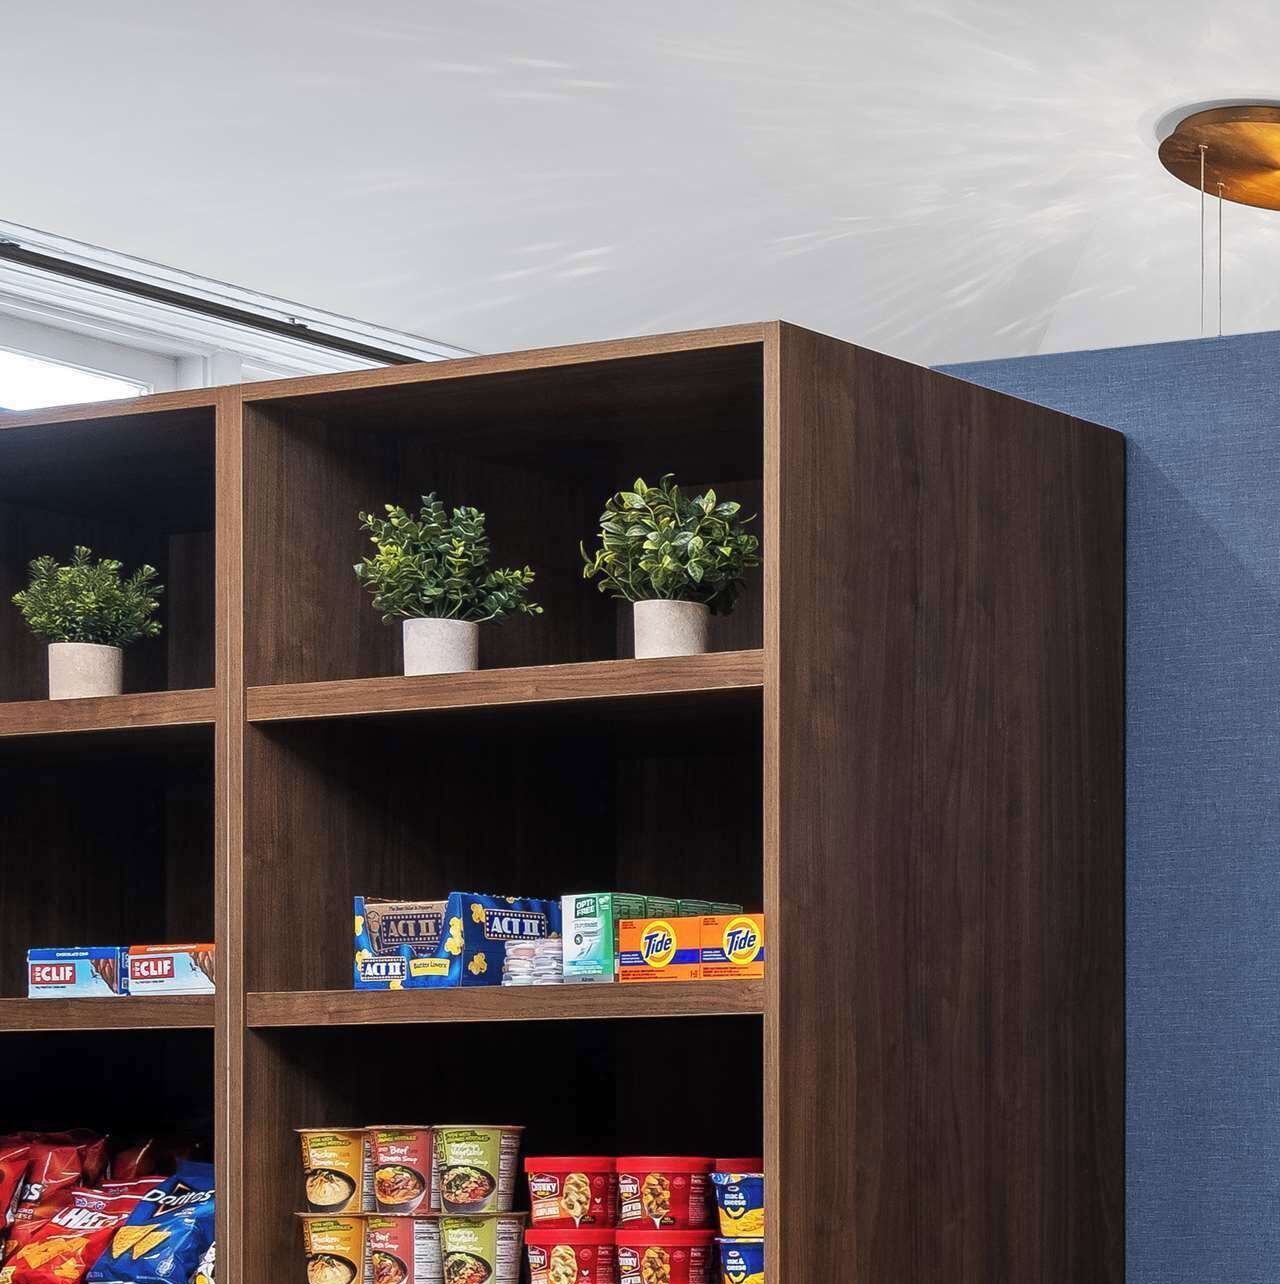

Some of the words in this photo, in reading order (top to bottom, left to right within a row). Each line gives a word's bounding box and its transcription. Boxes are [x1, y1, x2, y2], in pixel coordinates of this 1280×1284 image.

[388, 920, 415, 937] ACT
[490, 917, 522, 935] ACT
[645, 933, 672, 958] Tide
[727, 931, 757, 955] Tide
[41, 966, 73, 982] CLIF
[140, 960, 171, 976] CLIF
[365, 962, 387, 976] ACT
[142, 1188, 216, 1206] Doritos
